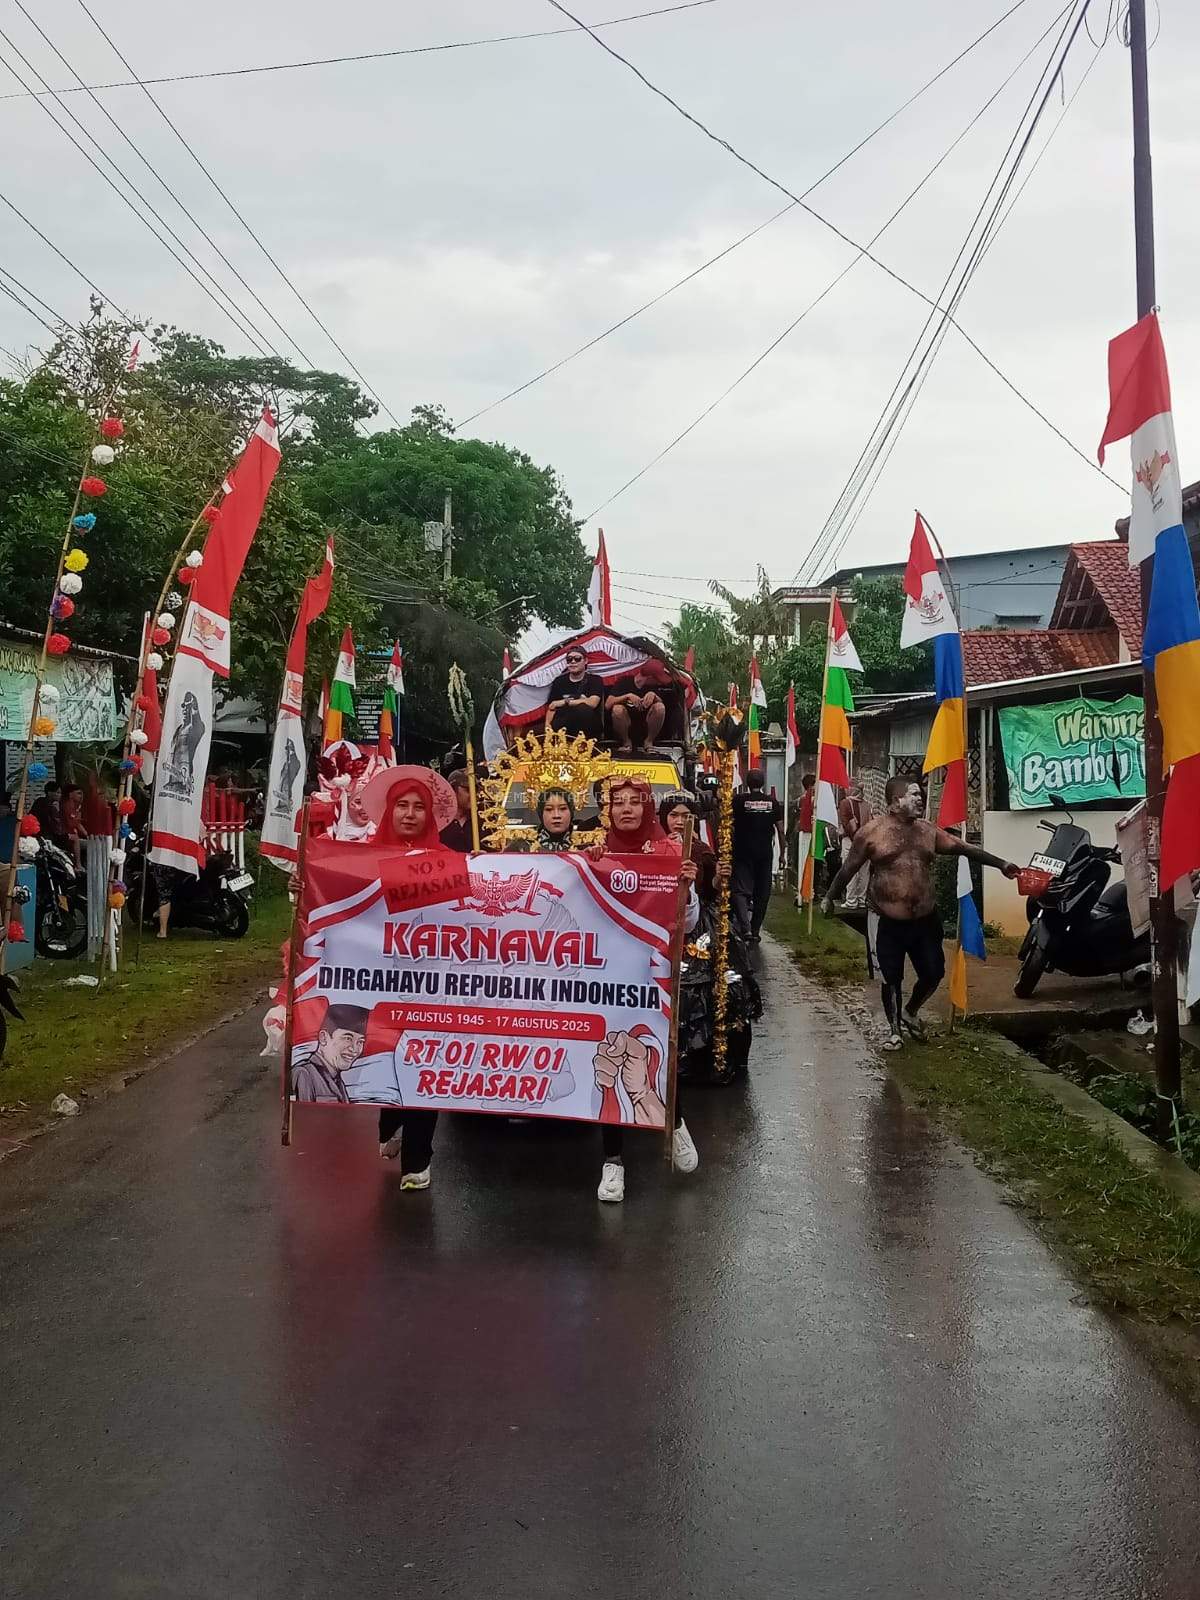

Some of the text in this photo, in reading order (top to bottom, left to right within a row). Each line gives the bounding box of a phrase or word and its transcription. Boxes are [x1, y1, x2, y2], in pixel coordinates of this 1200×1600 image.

[408, 859, 446, 875] NO 9
[611, 869, 637, 893] 80
[383, 922, 606, 969] KARNAVAL
[318, 966, 662, 1011] DIRGAHAYU REPUBLIK INDONESIA
[390, 1010, 404, 1021] 17
[406, 1011, 453, 1024] AGUSTUS
[457, 1013, 485, 1026] 1945
[495, 1016, 509, 1027] 17
[511, 1017, 559, 1031] AGUSTUS
[562, 1020, 591, 1032] 2025
[404, 1039, 566, 1074] RT 01 RW 01
[416, 1071, 552, 1102] REJASARI
